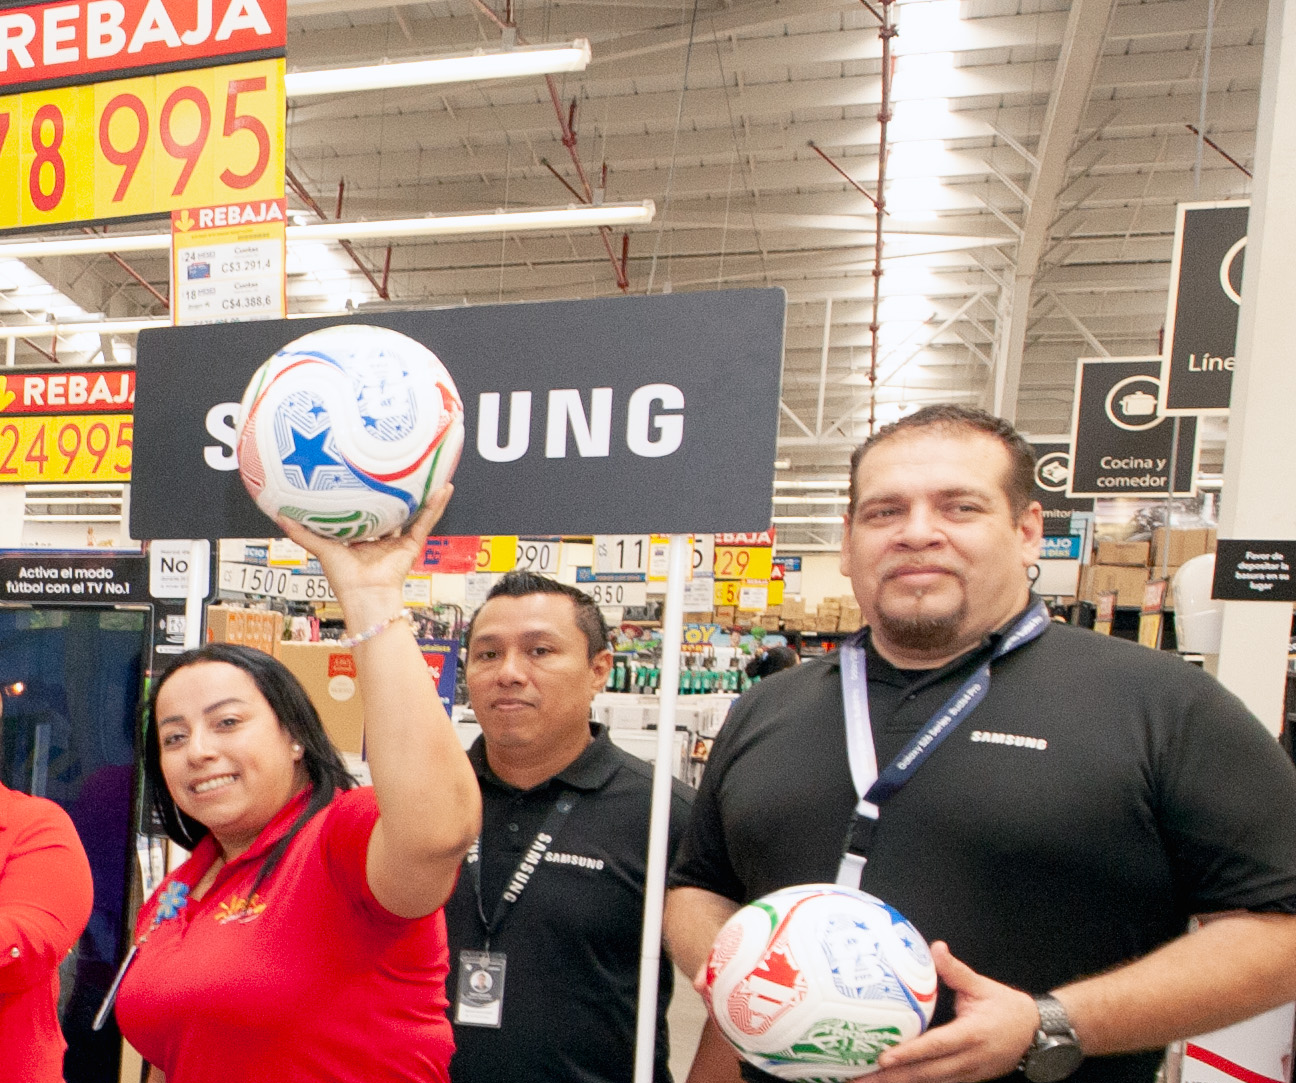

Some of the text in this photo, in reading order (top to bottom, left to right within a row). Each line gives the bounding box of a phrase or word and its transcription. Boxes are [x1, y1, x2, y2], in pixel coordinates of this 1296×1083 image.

[199, 201, 283, 228] REBAJA
[1188, 353, 1236, 372] Líne
[23, 374, 136, 406] REBAJ
[203, 382, 686, 471] SUNG
[0, 423, 134, 475] 24995
[1100, 456, 1167, 471] Cocina y
[1096, 473, 1168, 488] comedor
[18, 566, 114, 579] Activa el modo
[240, 567, 287, 595] 1500
[6, 580, 130, 595] fútbol con el TV No.1
[970, 730, 1048, 751] SAMSUNG
[504, 832, 553, 903] SAMSUNG
[544, 851, 605, 871] SAMSUNG
